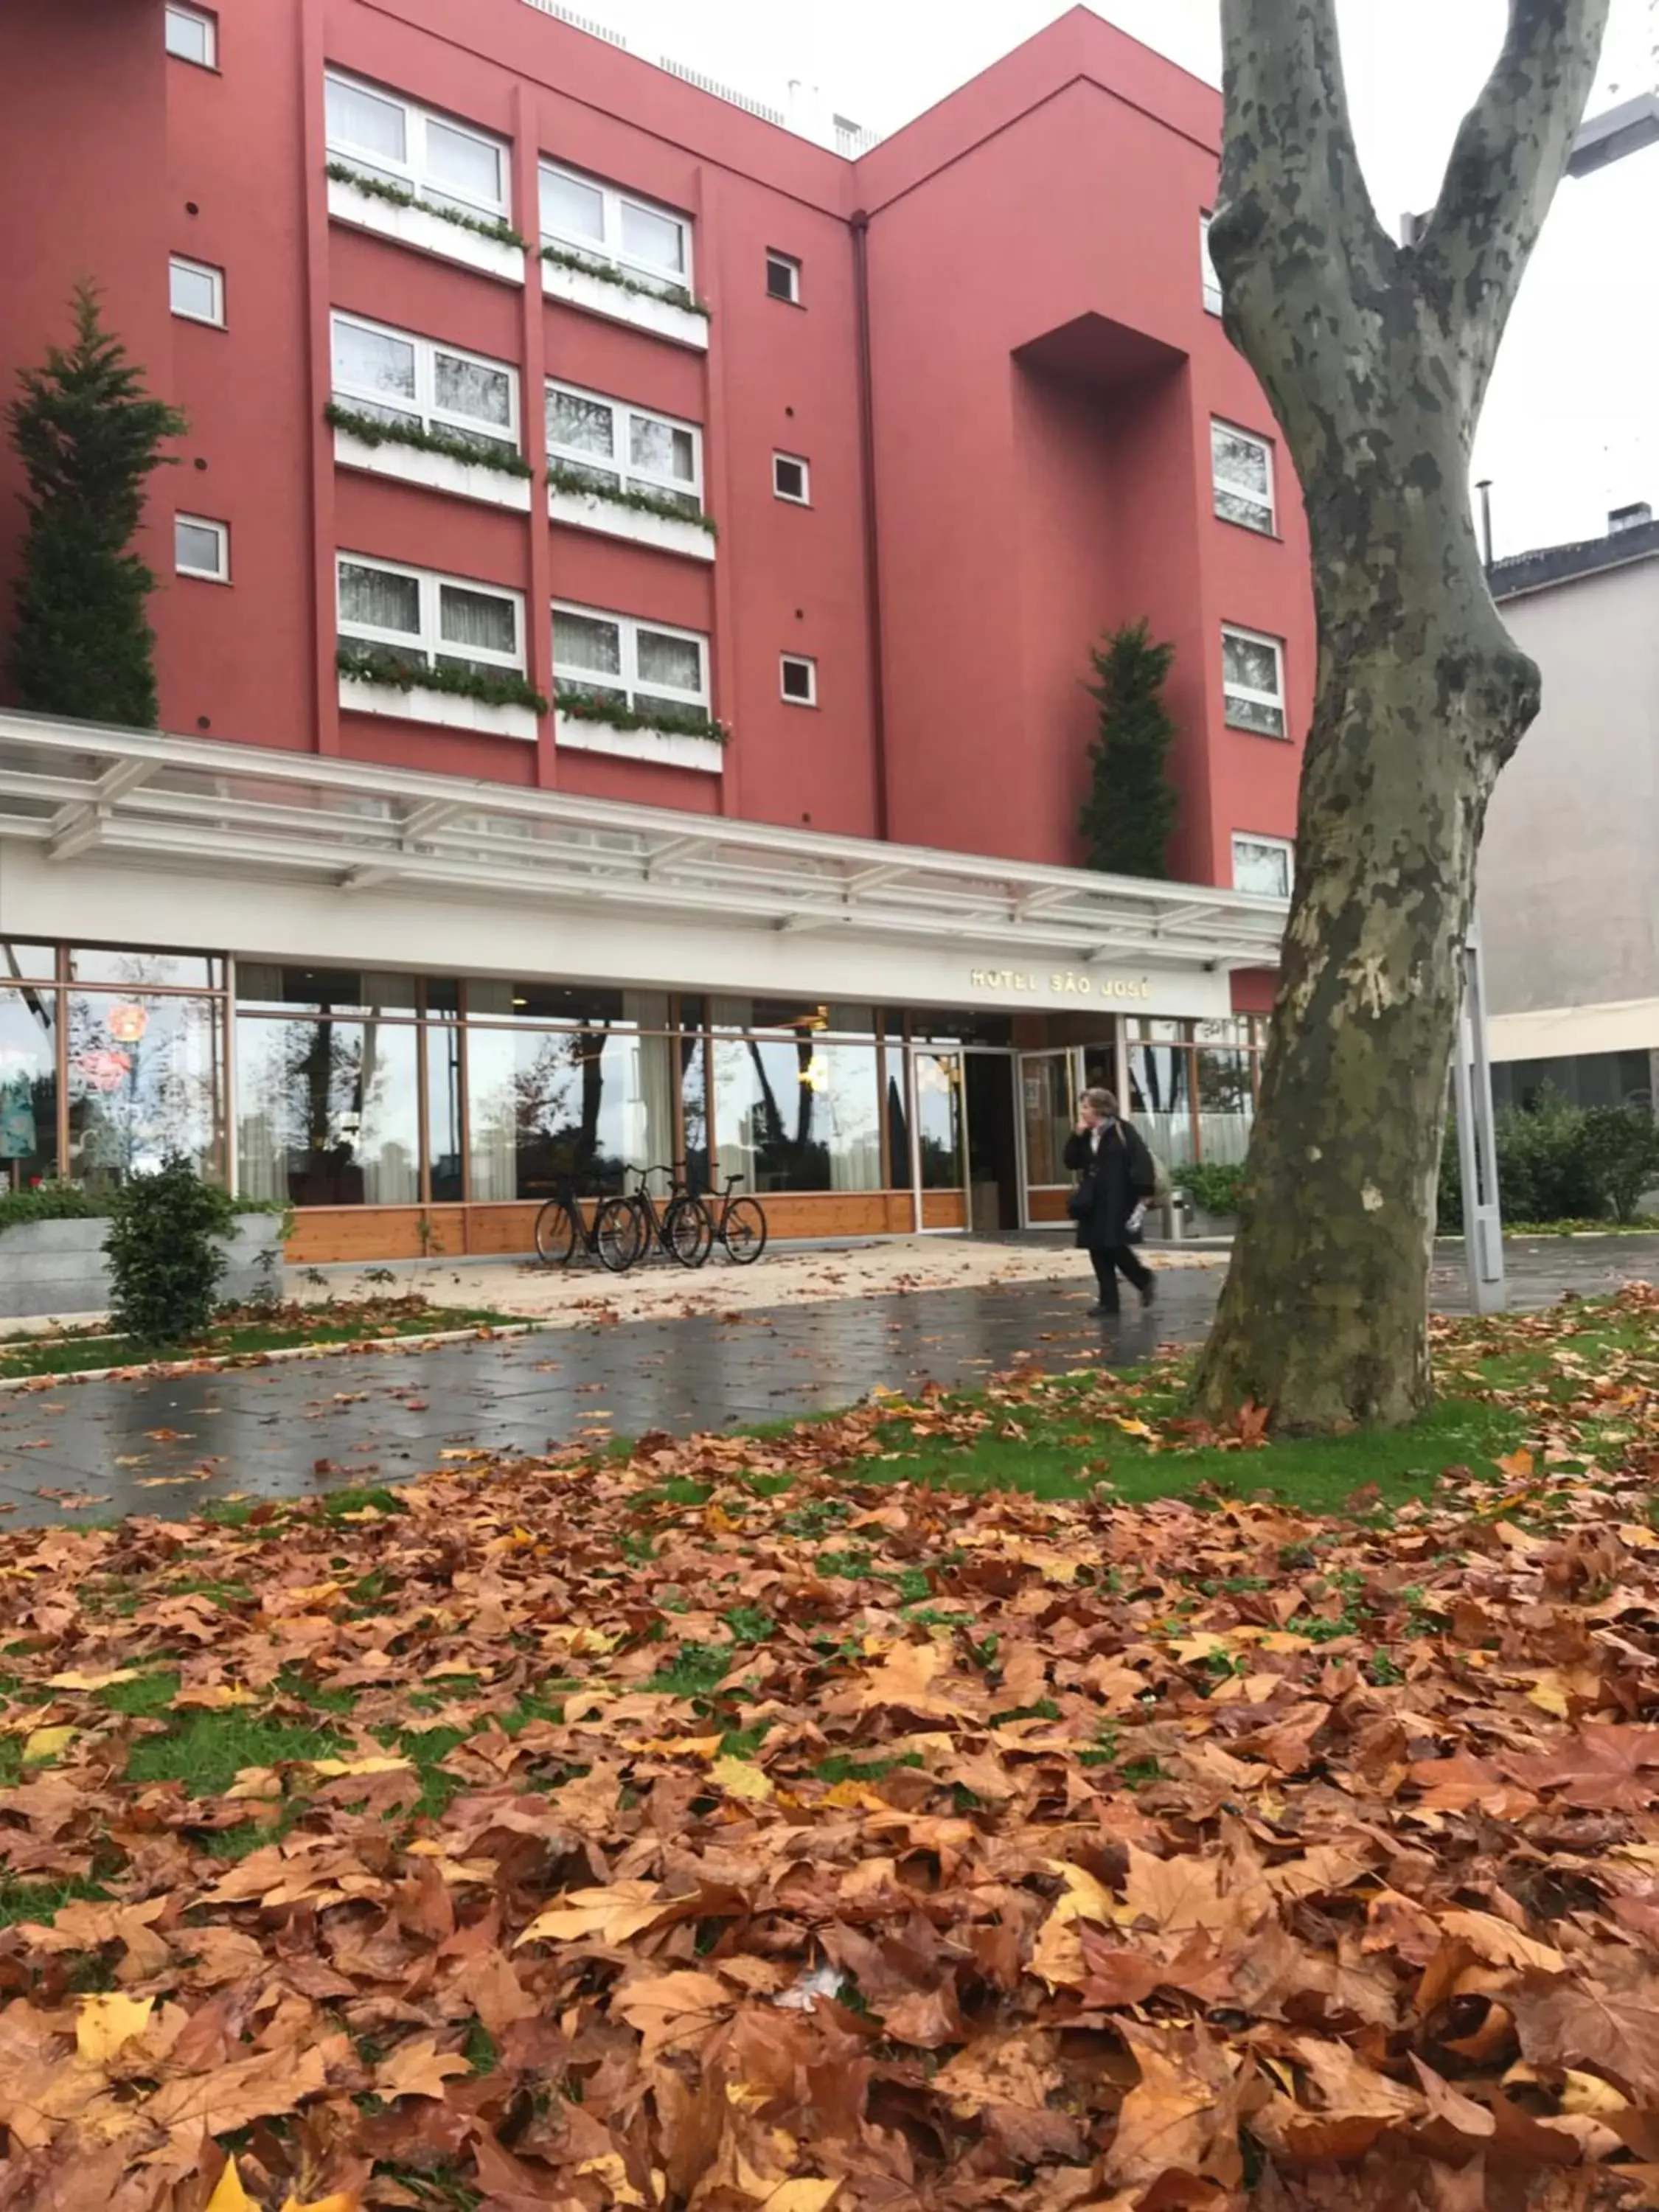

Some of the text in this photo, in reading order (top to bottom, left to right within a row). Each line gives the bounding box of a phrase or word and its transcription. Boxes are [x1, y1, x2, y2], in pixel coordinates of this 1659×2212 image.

[971, 969, 1150, 998] HOTEL SÃO JOSÉ
